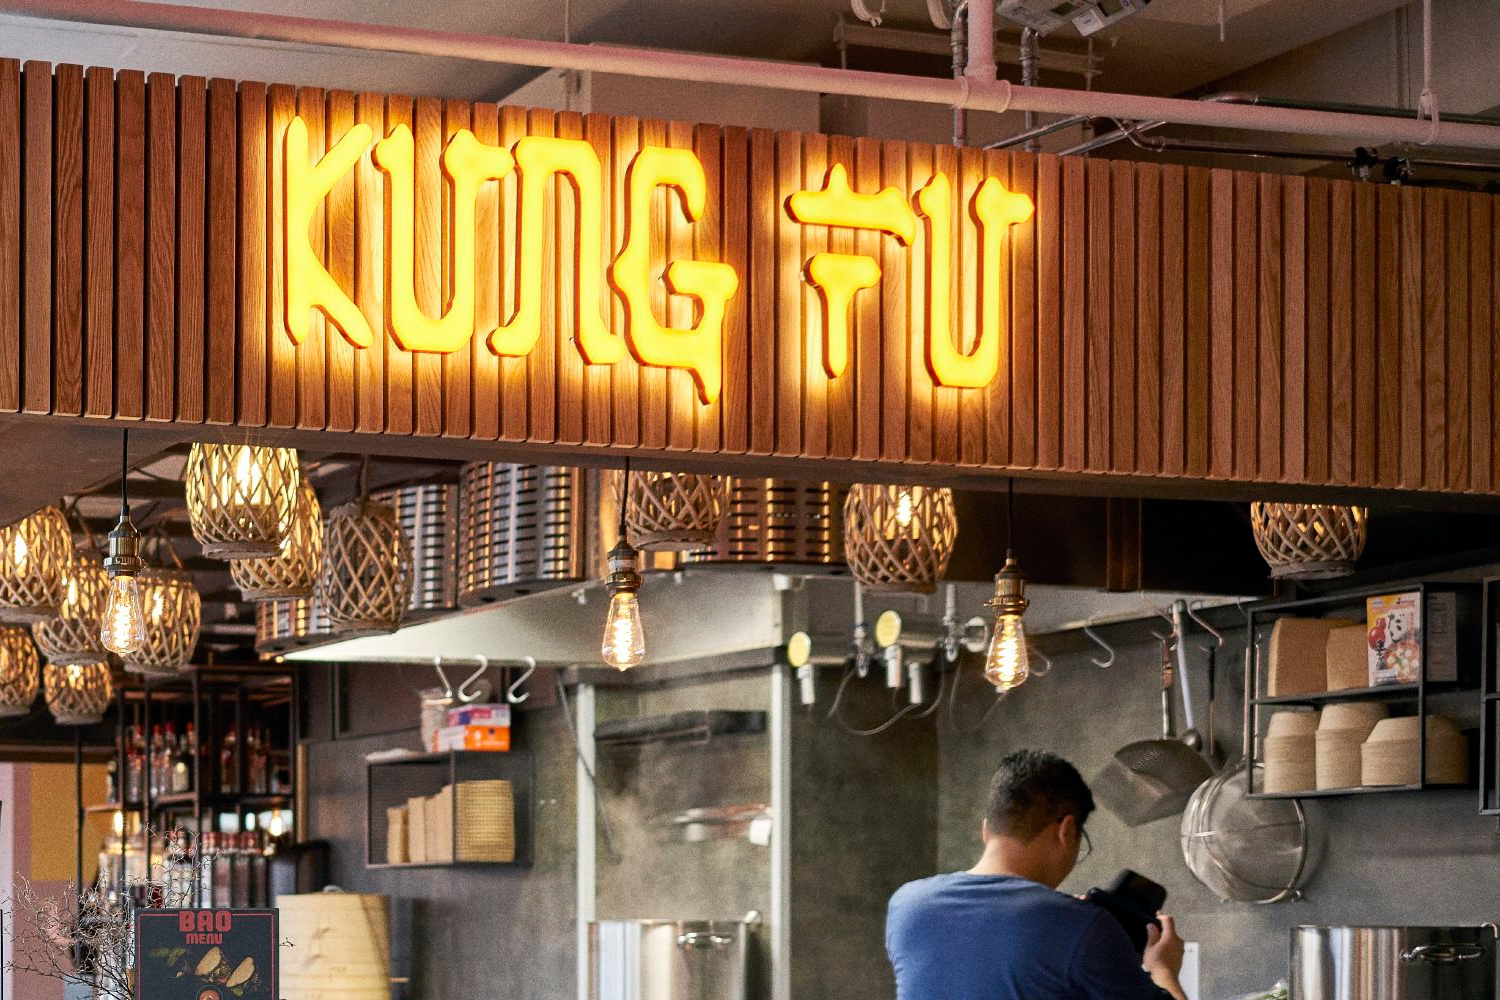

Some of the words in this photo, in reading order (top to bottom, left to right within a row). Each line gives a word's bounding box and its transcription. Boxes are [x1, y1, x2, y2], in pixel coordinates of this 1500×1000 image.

[284, 115, 739, 405] KUNG
[784, 161, 1036, 389] FU
[180, 910, 232, 932] BAO
[186, 933, 223, 945] MENU
